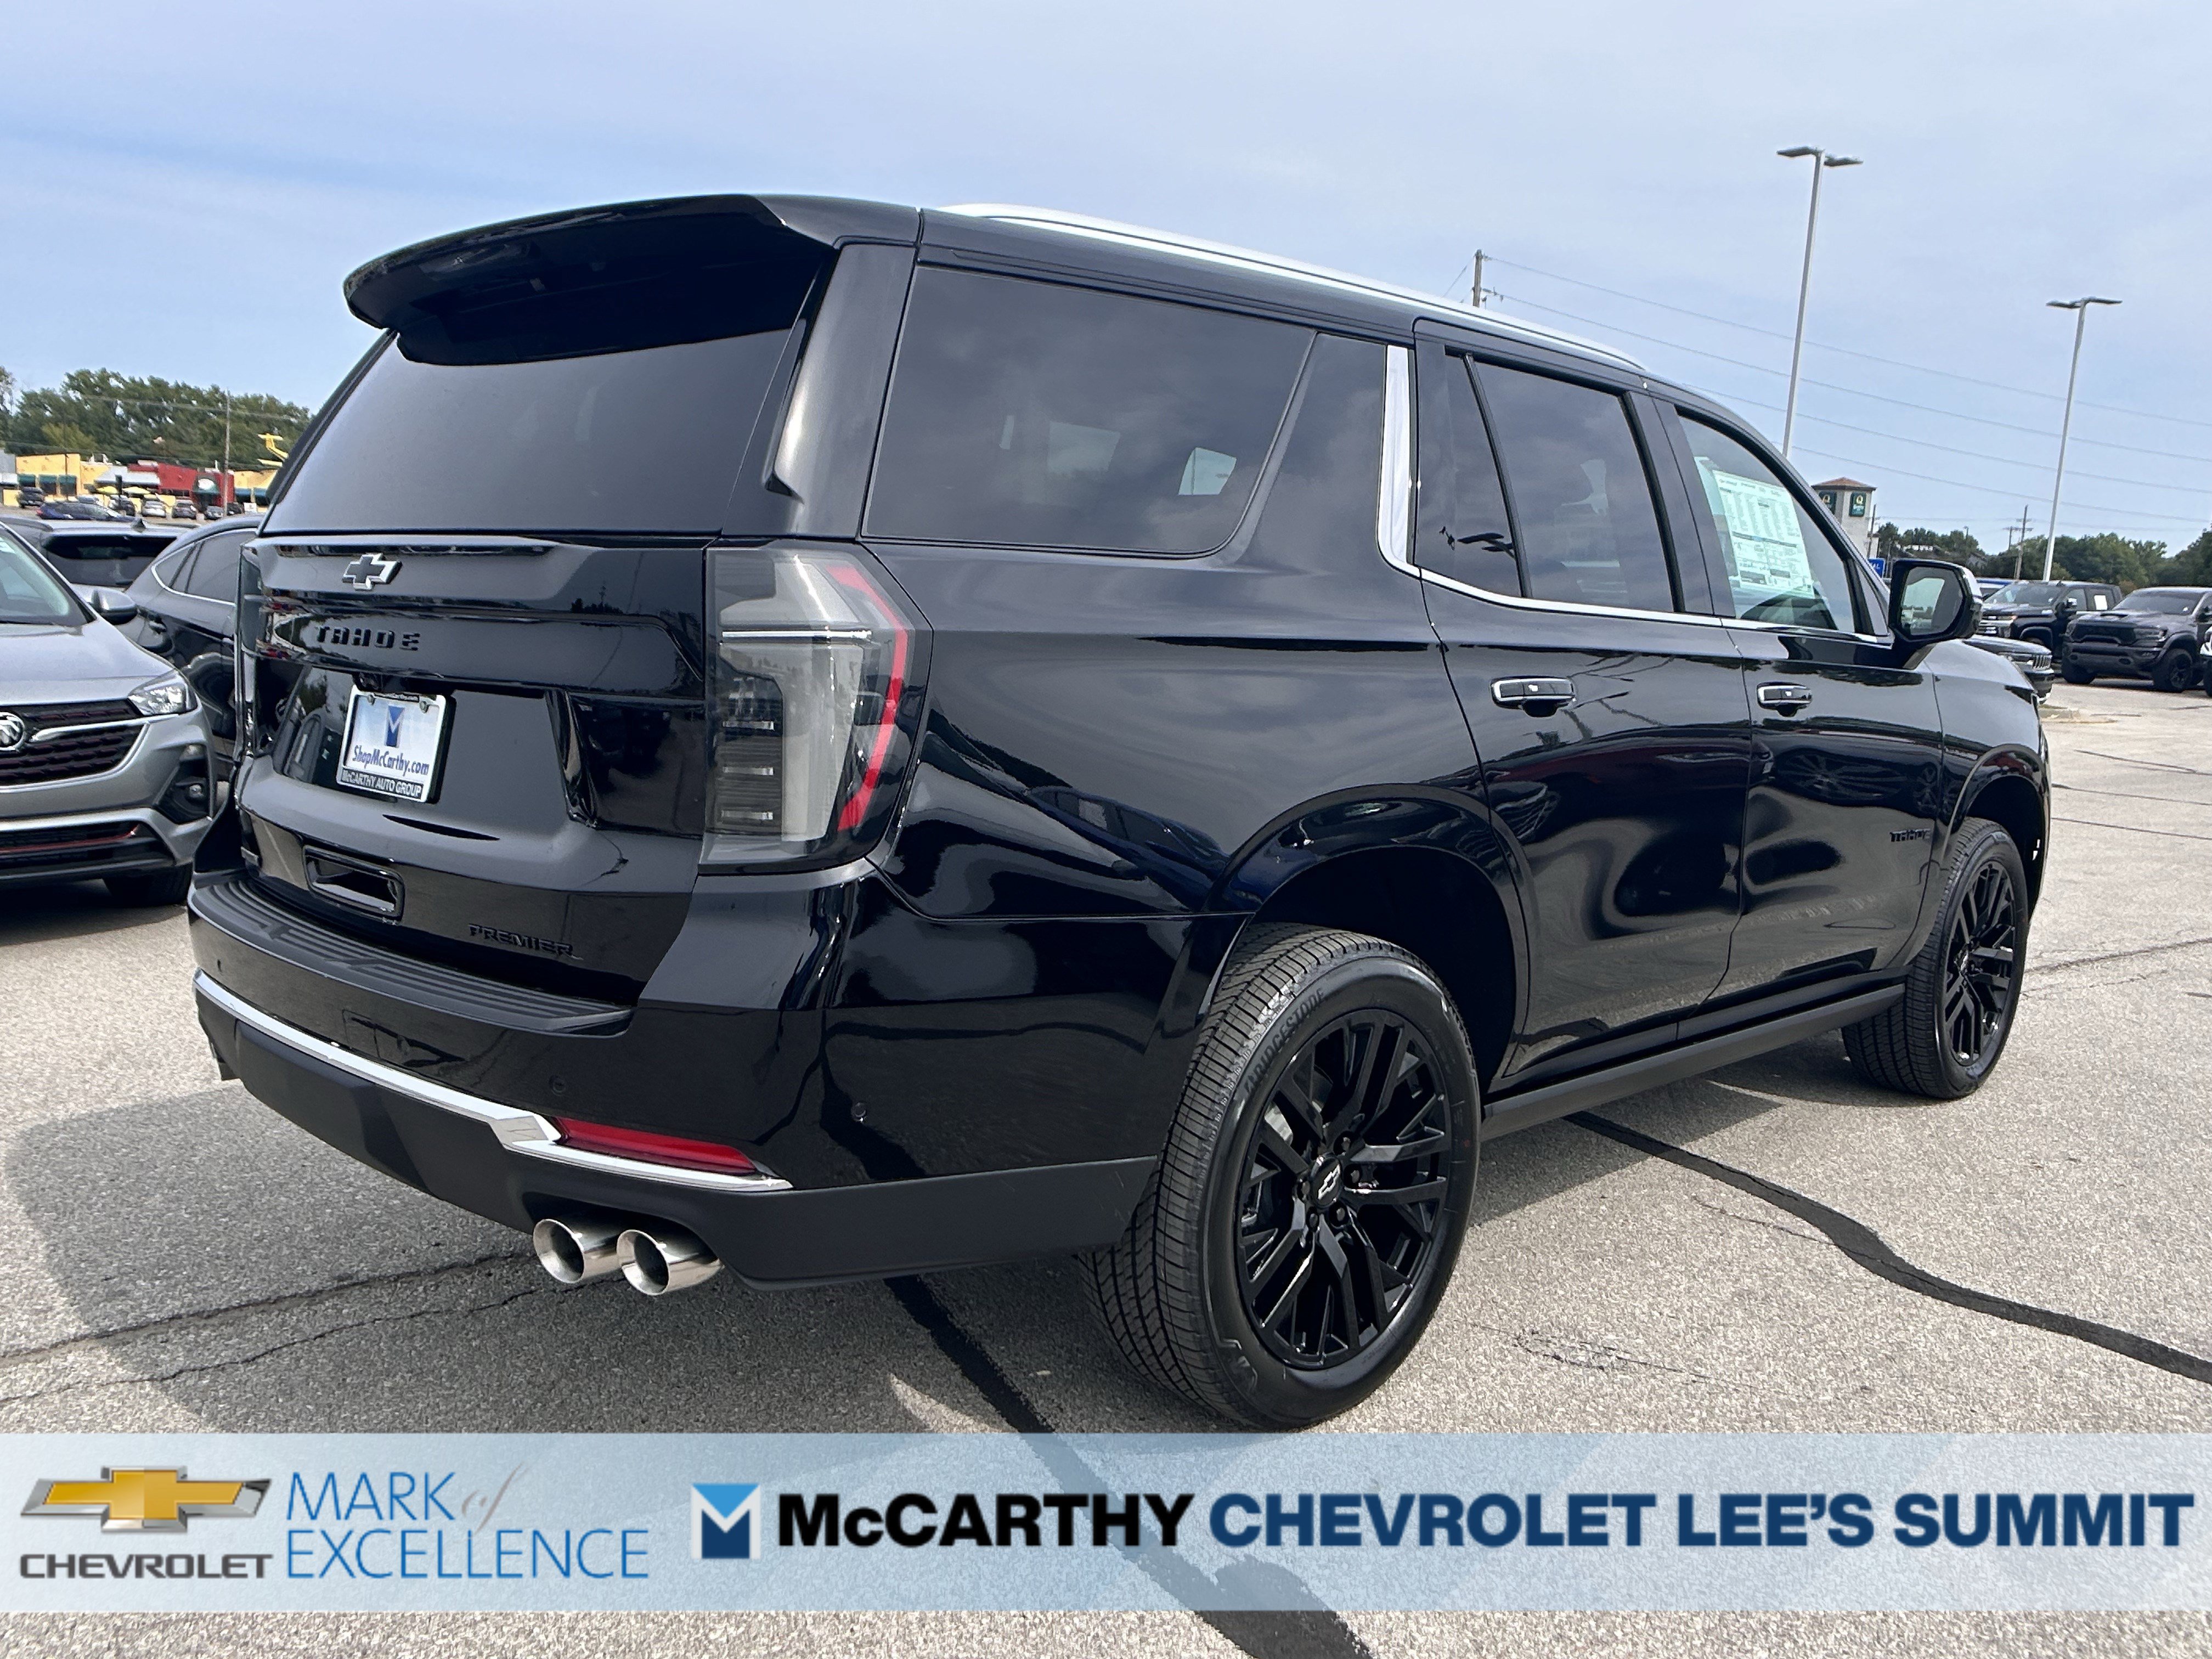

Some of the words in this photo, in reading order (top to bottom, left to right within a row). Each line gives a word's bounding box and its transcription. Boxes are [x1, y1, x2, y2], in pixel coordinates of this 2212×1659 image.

[315, 625, 421, 651] TAHOE
[352, 744, 430, 776] ShopMcCarthy.com
[376, 777, 395, 791] AUTO
[395, 781, 421, 798] GROUP
[468, 923, 584, 961] PREMIER
